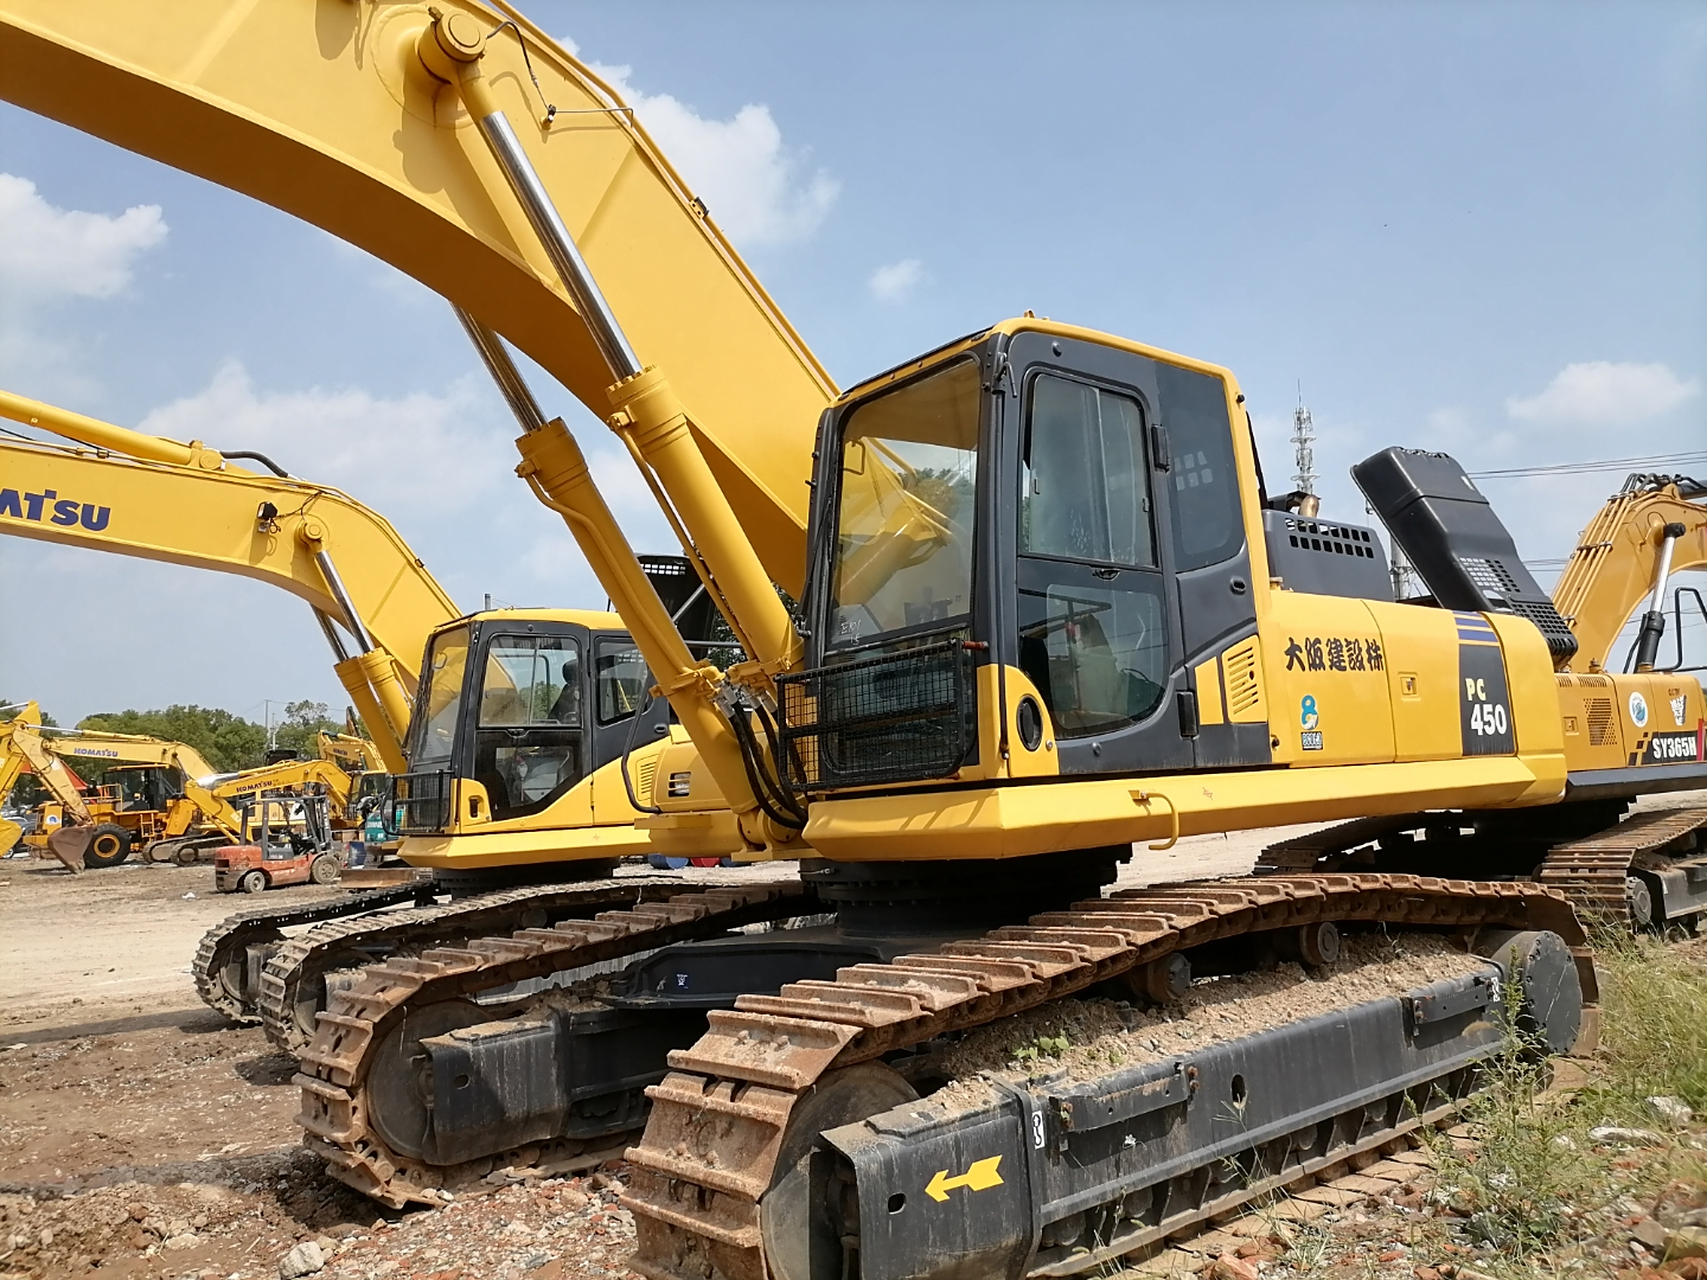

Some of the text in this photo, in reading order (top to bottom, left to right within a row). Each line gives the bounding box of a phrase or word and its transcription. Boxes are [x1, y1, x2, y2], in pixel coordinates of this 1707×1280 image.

[1465, 678, 1486, 701] PC
[1470, 703, 1507, 736] 450
[73, 747, 119, 758] KOMATSU
[1652, 736, 1697, 759] SY365H
[236, 780, 273, 793] KOMATSU
